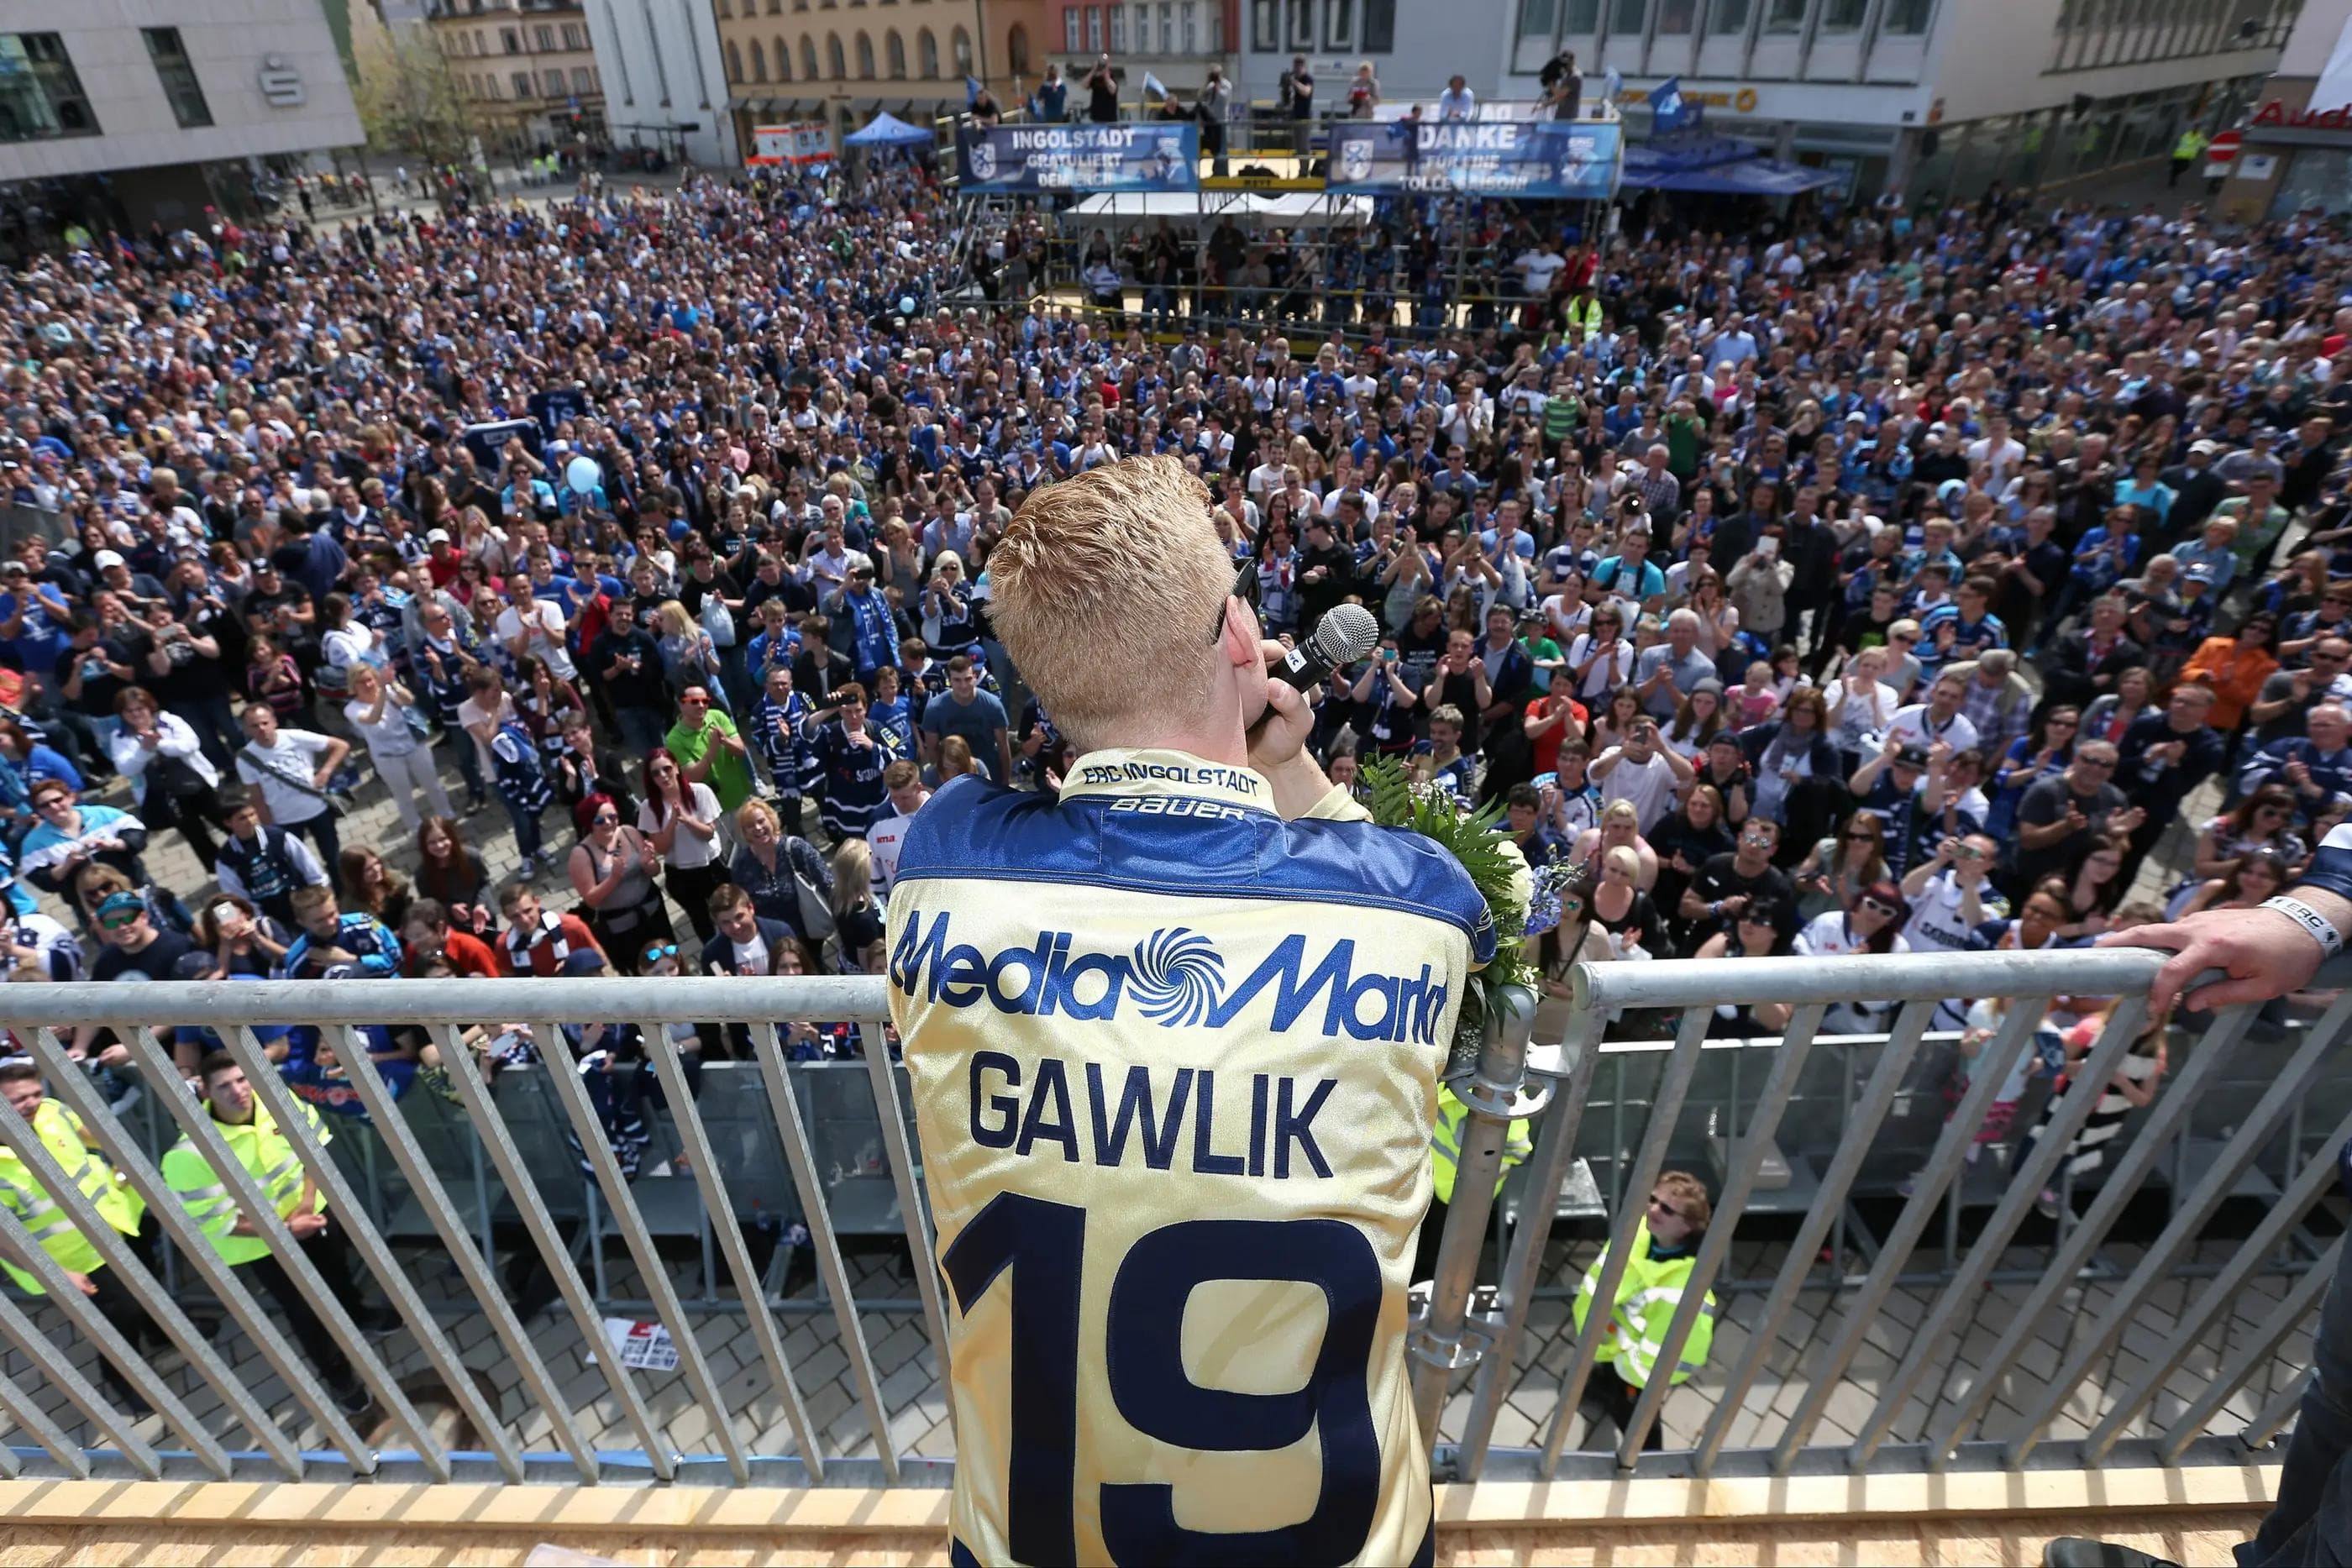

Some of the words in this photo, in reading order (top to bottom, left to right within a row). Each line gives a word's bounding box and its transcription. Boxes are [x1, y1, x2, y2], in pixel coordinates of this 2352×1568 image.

[2251, 98, 2352, 129] Aud
[1012, 129, 1135, 149] INGOLSTADT
[1417, 124, 1518, 149] DANKE
[1026, 153, 1123, 168] GRATULIERT
[1084, 764, 1122, 785] ERC
[1125, 763, 1258, 798] INGOLSTADT
[2286, 902, 2324, 928] ERC
[888, 910, 1131, 1022] Media
[969, 1050, 1338, 1179] GAWLIK
[942, 1189, 1383, 1568] 19
